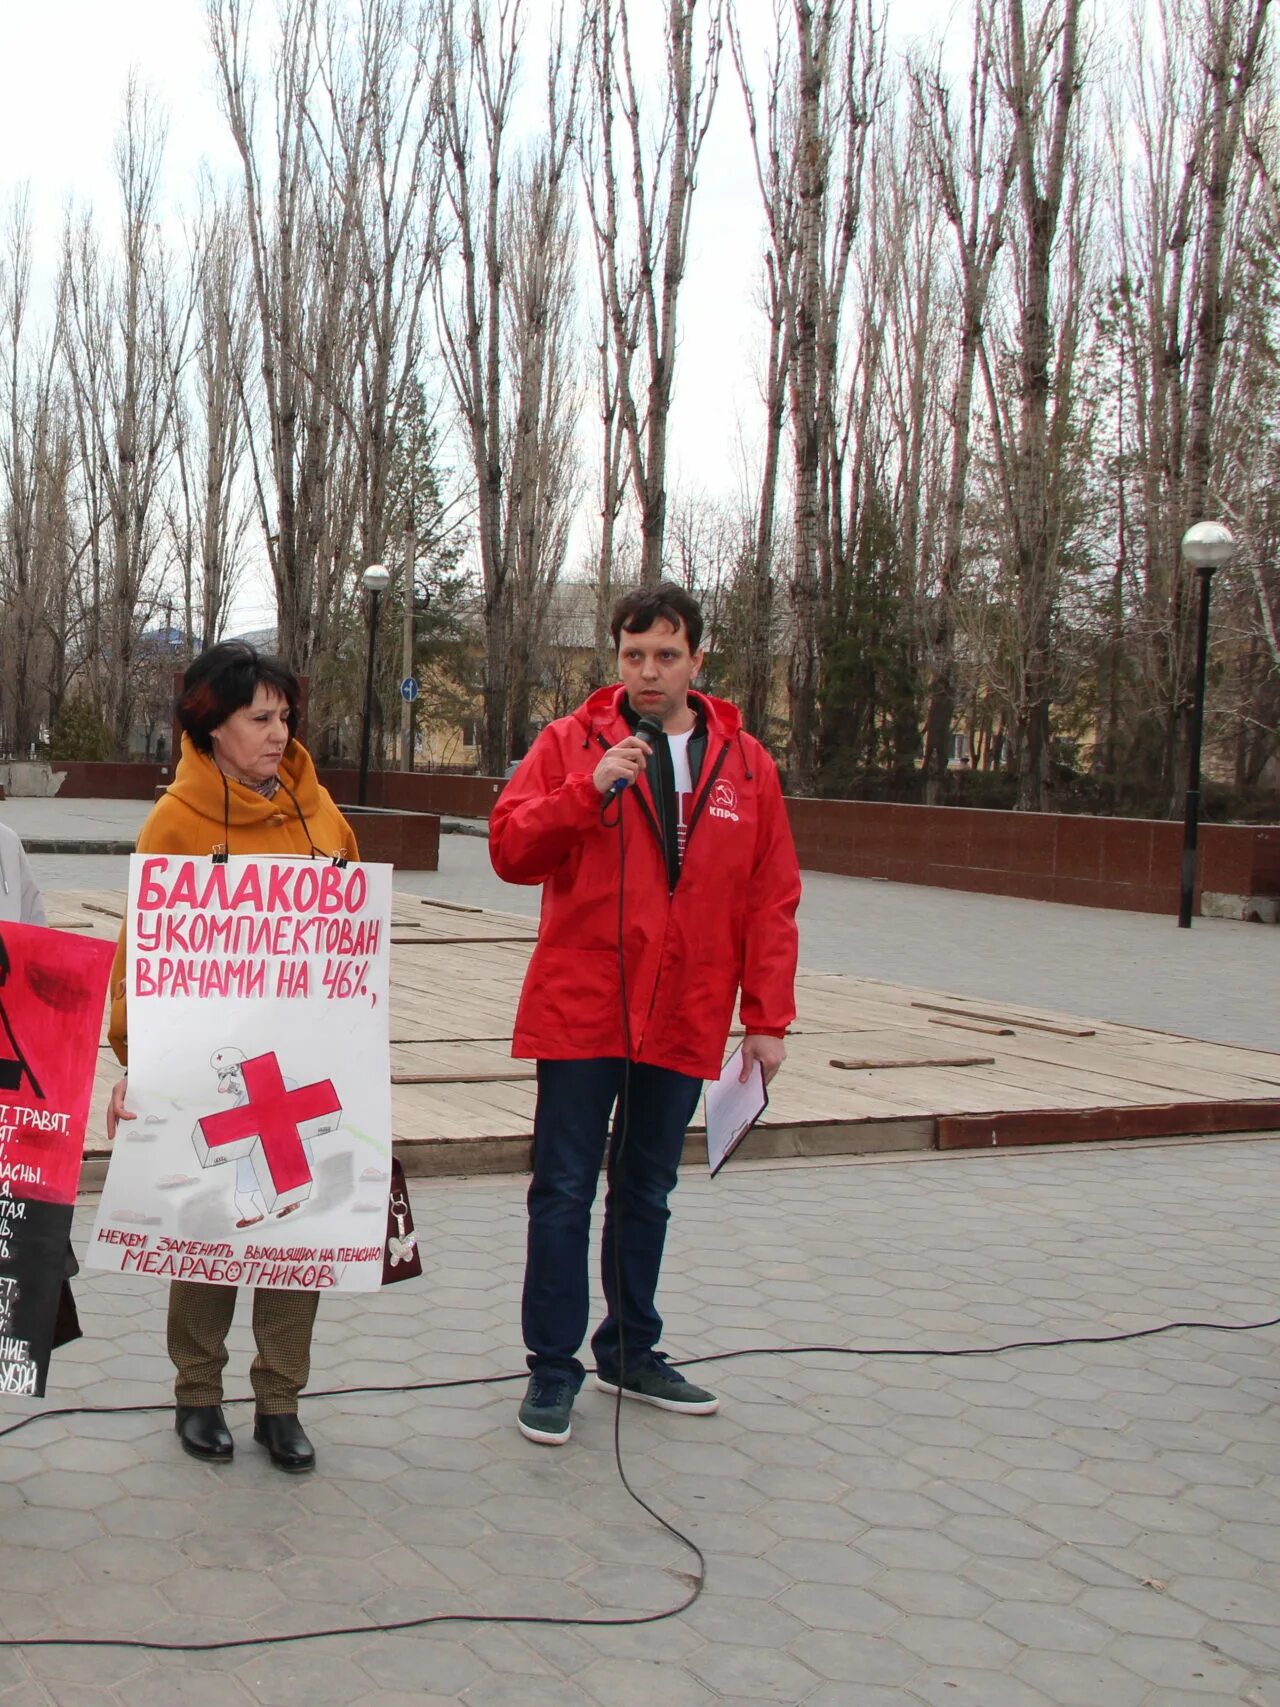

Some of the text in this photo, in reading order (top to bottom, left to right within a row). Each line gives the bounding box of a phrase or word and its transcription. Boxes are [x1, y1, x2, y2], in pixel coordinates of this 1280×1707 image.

[709, 806, 739, 822] КПРФ
[137, 857, 367, 915] БАЛАКОВО
[137, 912, 380, 956] УКОМПЛЕКТОВАН
[136, 957, 266, 999] ВРАЧАМИ
[277, 960, 308, 999] НА
[13, 1106, 71, 1136] ТРАВЯТ,
[97, 1228, 382, 1262] НЕКЕМ ЗАМЕНИТЬ ВЫХОДЯЩИХ НА ПЕНСИЮ
[120, 1250, 336, 1289] МЕДРАБОТНИКОВ
[1, 1361, 38, 1395] УБОЙ
